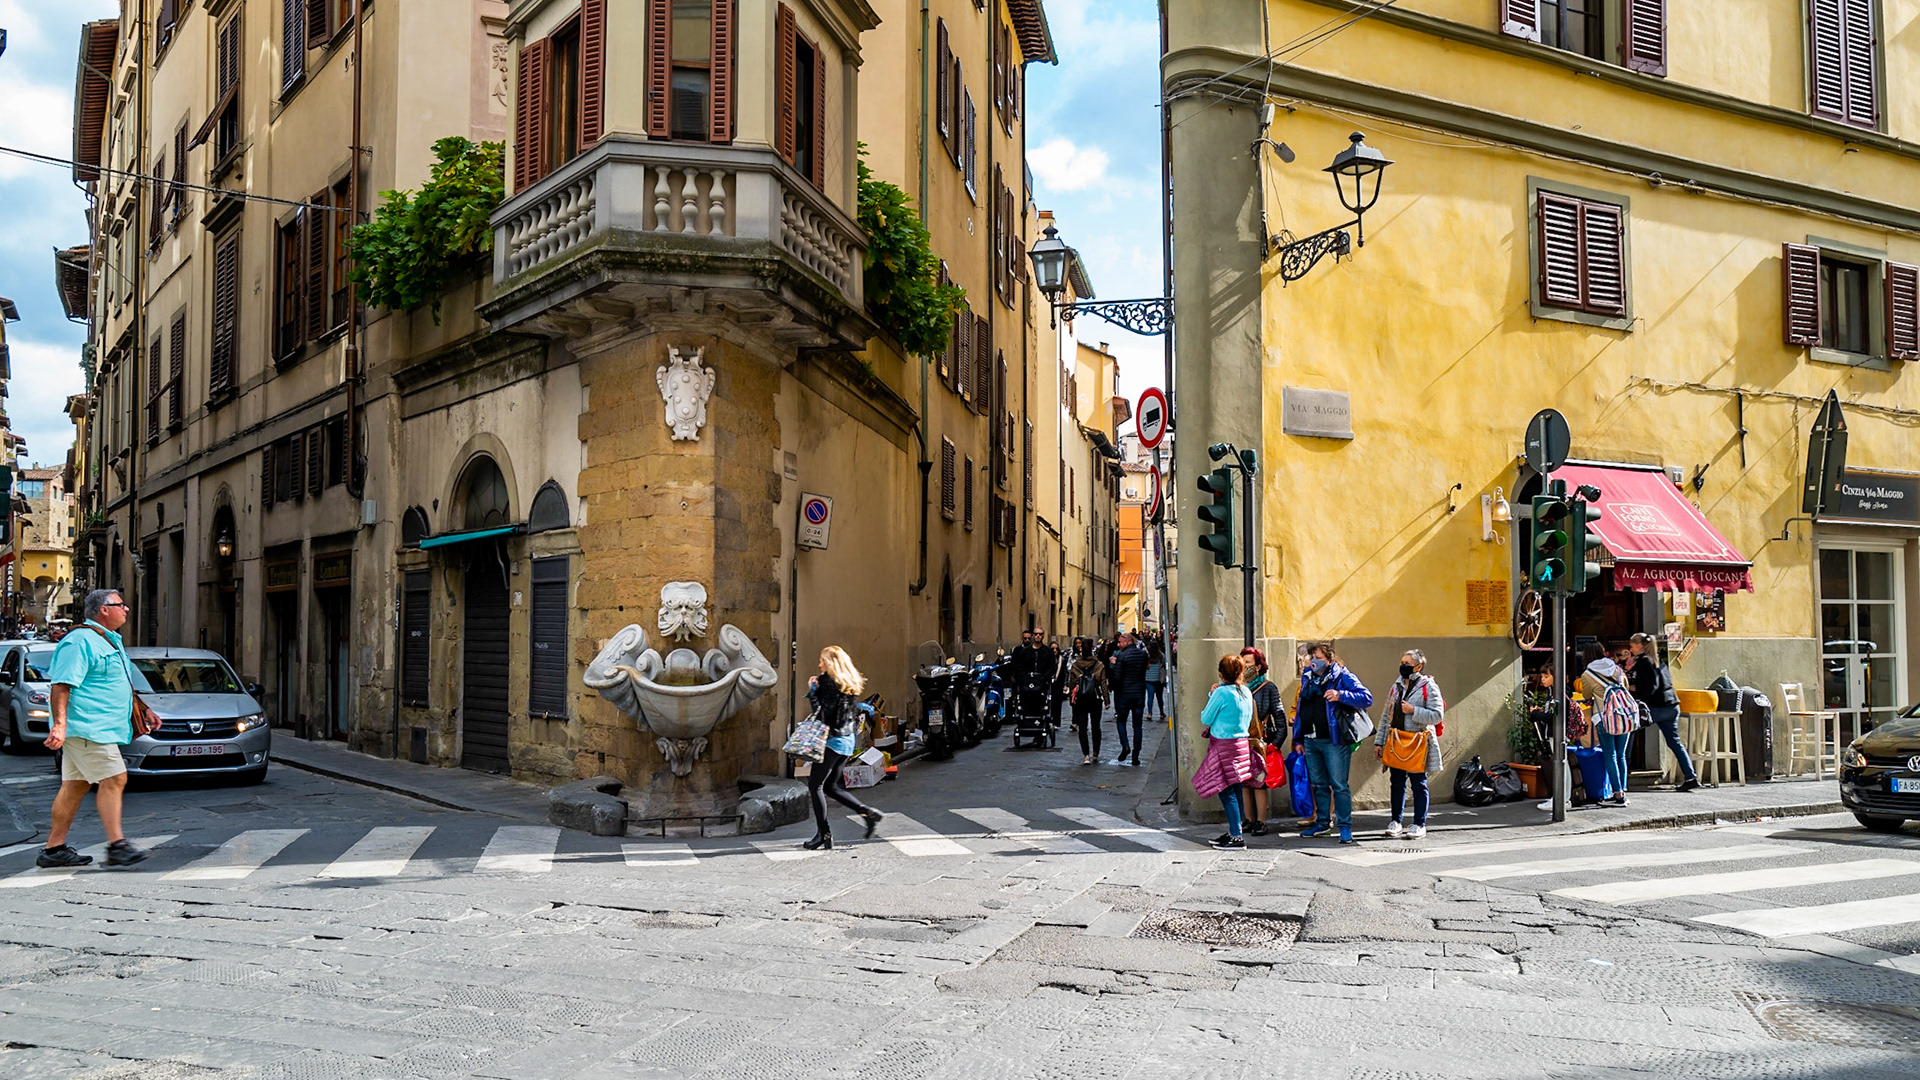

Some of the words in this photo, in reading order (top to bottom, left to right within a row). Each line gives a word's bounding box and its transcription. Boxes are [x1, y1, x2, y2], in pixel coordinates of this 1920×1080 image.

[1291, 404, 1307, 413] VIA
[1313, 405, 1347, 416] MAGGIO
[1842, 484, 1865, 497] CINZIA
[1876, 487, 1904, 499] MAGGIO
[1620, 513, 1656, 523] FORNO
[1622, 567, 1639, 579] AZ.
[1643, 568, 1695, 581] AGRICOLE
[1698, 569, 1746, 582] TOSCANE
[1674, 601, 1687, 610] OPEN
